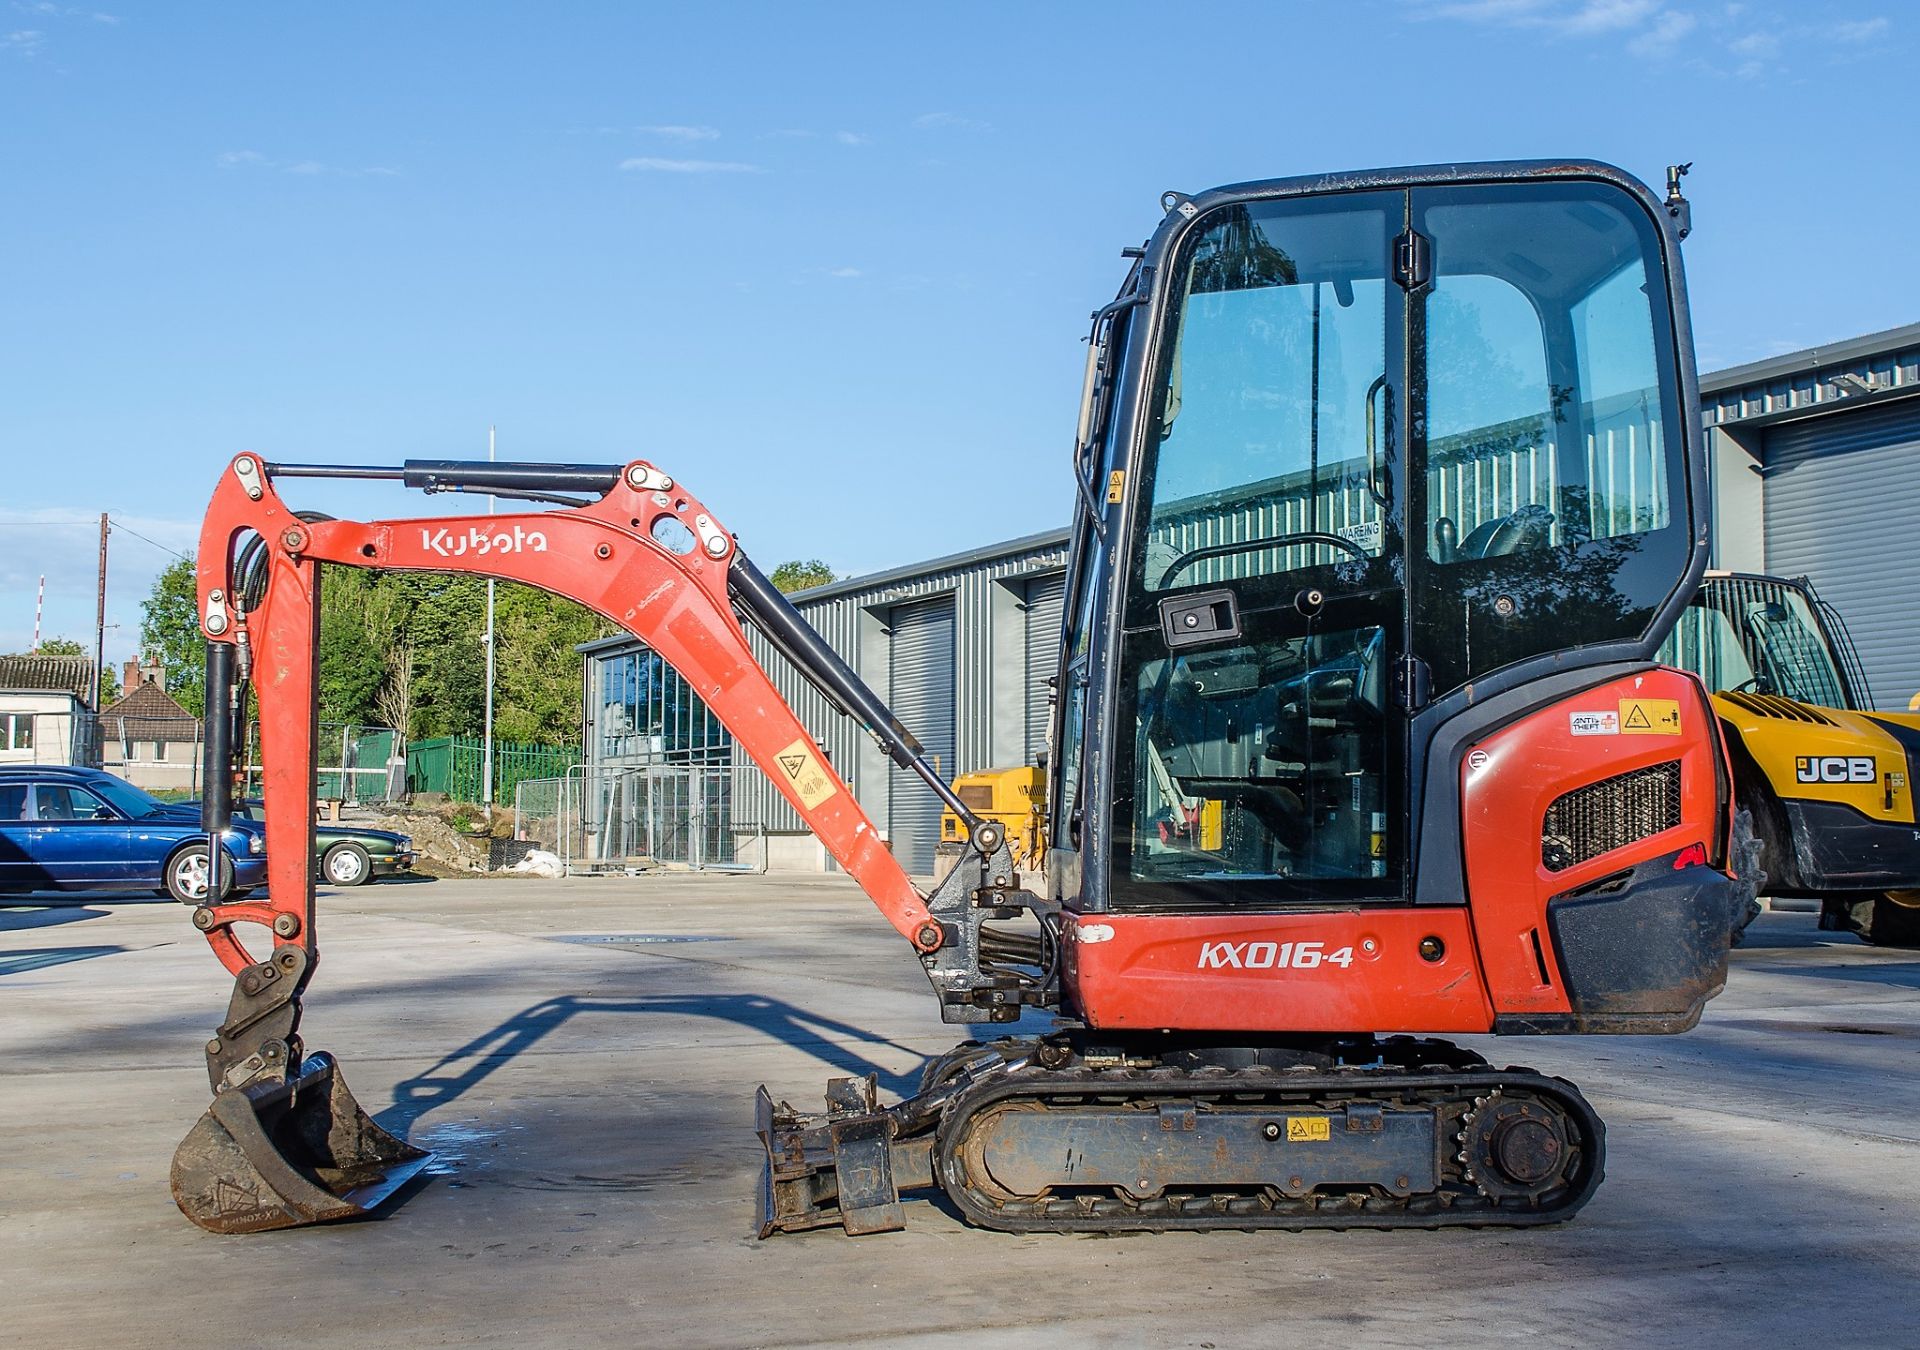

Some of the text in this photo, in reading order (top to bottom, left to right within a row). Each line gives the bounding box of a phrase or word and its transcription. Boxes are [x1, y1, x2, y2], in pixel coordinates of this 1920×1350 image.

[422, 525, 548, 557] Kubota
[1797, 758, 1875, 782] JCB
[1197, 941, 1354, 969] KX016-4
